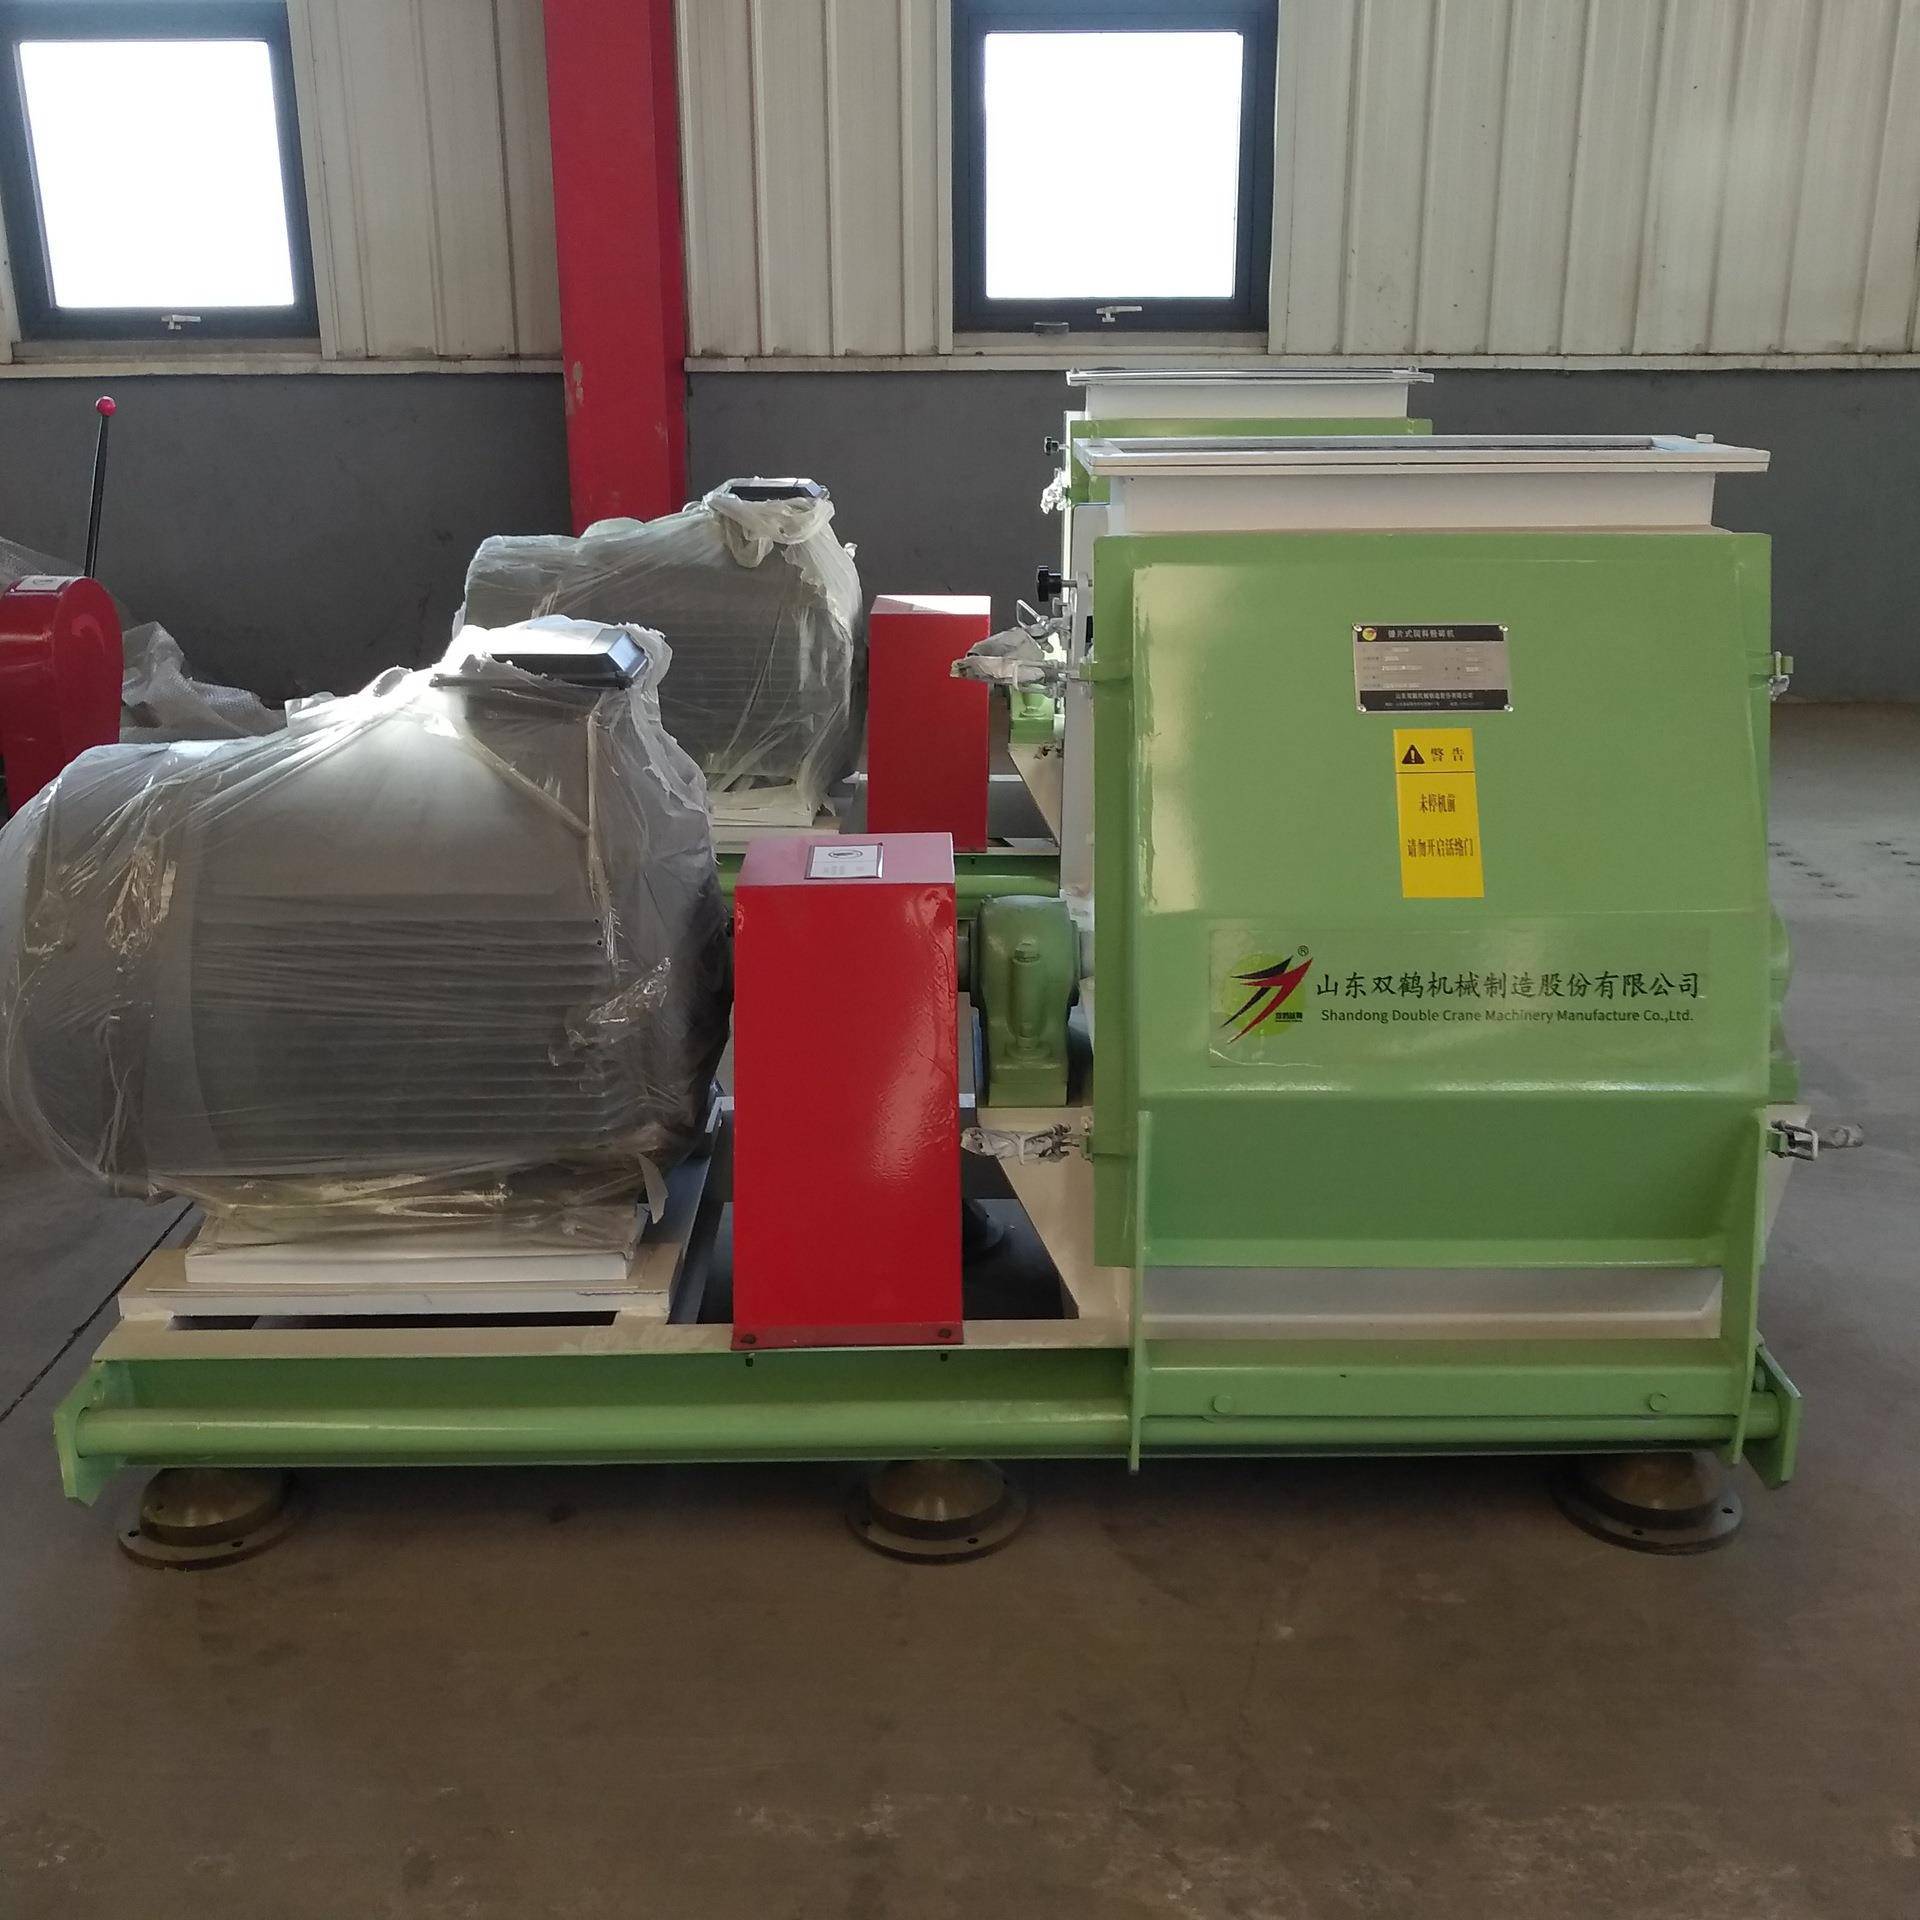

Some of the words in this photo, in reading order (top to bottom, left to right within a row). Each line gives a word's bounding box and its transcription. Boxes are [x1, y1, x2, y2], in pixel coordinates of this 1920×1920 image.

[1419, 793, 1456, 813] 未停机前
[1316, 970, 1699, 1000] 山东双鹤机械制造股份有限公司
[1321, 1009, 1388, 1024] Shandong
[1392, 1009, 1438, 1022] Double
[1443, 1009, 1482, 1022] Crane
[1485, 1009, 1553, 1024] Machinery
[1557, 1009, 1639, 1022] Manufacture
[1643, 1009, 1694, 1024] Co.,Ltd.
